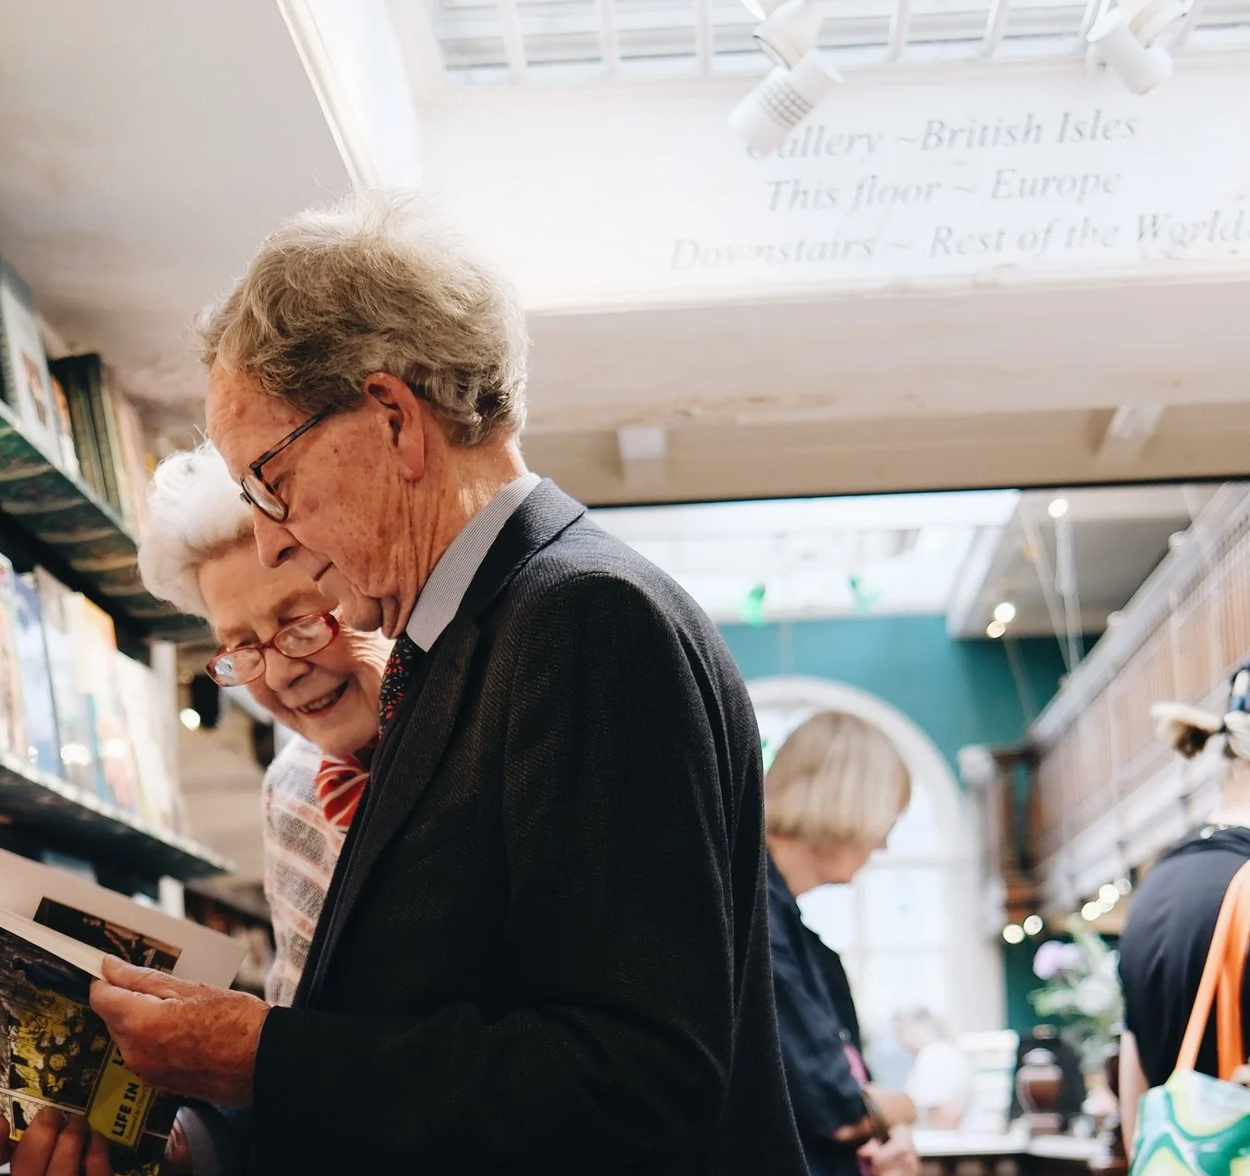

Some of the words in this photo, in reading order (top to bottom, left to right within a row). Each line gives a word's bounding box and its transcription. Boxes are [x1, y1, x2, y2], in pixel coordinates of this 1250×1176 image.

[1057, 109, 1139, 144] Isles
[767, 179, 838, 212] This
[848, 174, 942, 216] floor
[991, 168, 1121, 205] Europe
[670, 232, 873, 270] Downstairs
[930, 225, 1006, 257] Rest
[1017, 216, 1062, 251] of
[1065, 217, 1120, 249] the
[112, 1104, 132, 1137] LIFE
[123, 1082, 139, 1102] IN
